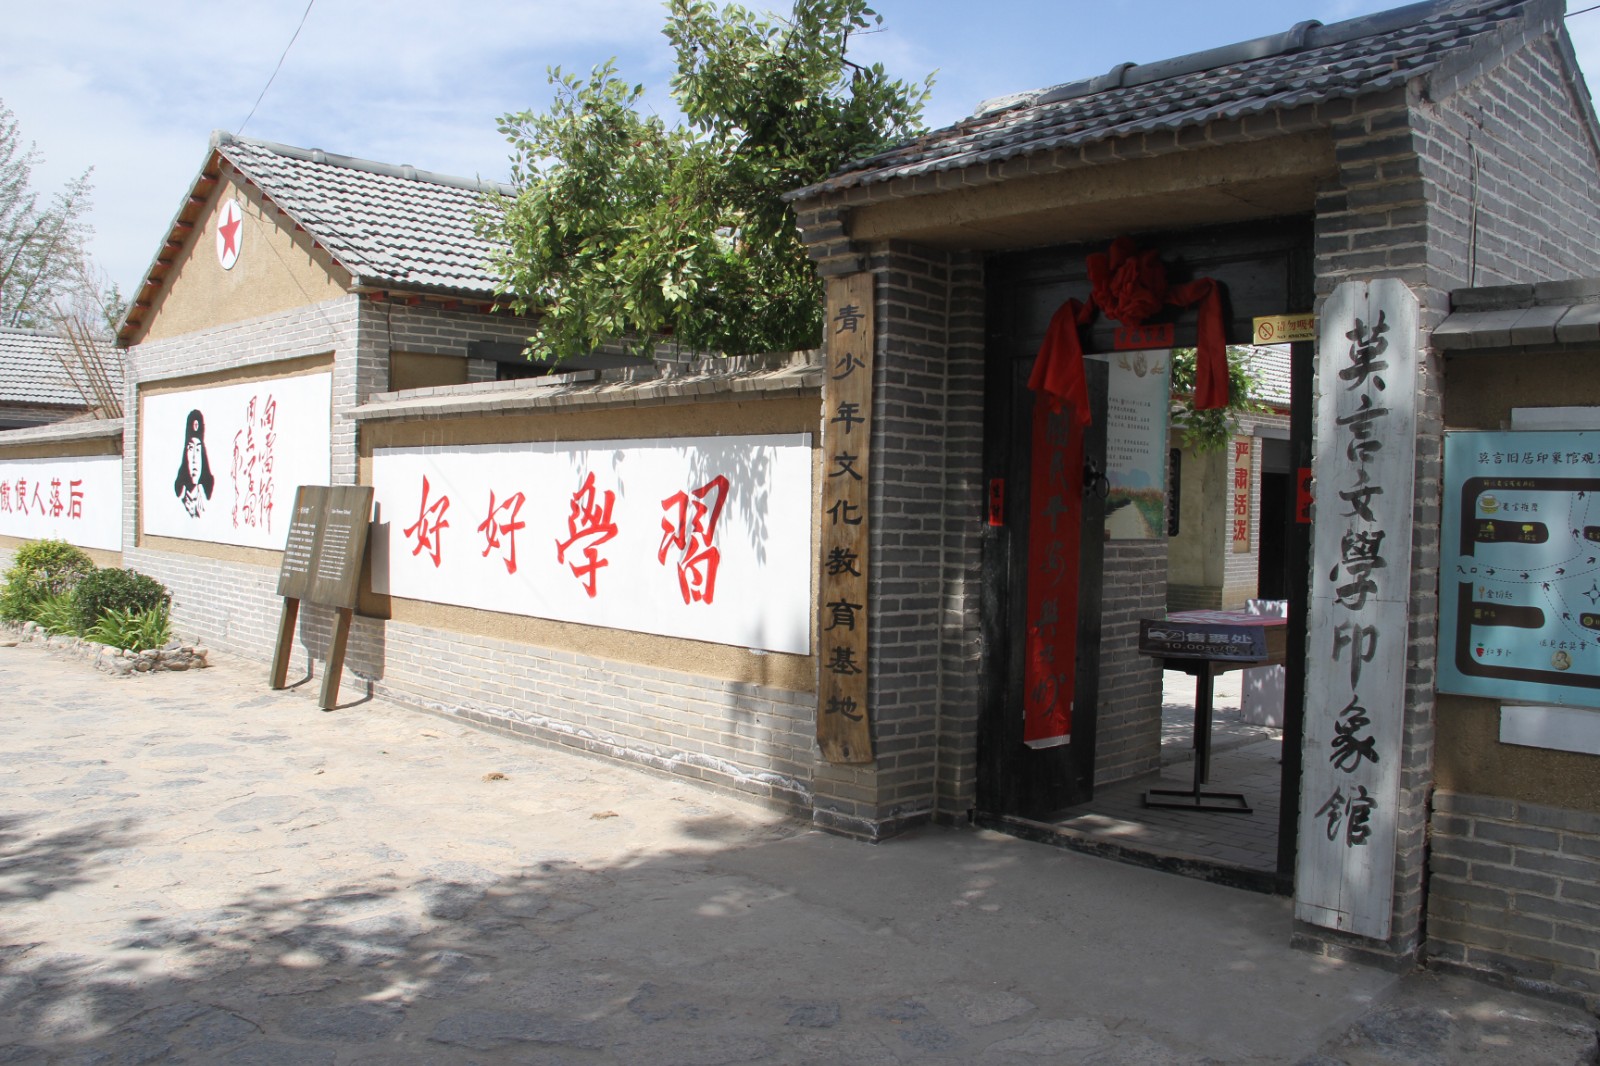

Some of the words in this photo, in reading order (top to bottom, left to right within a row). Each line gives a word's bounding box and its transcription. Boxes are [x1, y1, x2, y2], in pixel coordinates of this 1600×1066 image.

[1478, 451, 1600, 466] 莫言旧居印象馆观
[1232, 442, 1249, 542] 严肃活泼
[824, 303, 866, 722] 青少年文化教育基地
[1456, 565, 1478, 575] 入口
[1186, 632, 1253, 645] 售票处
